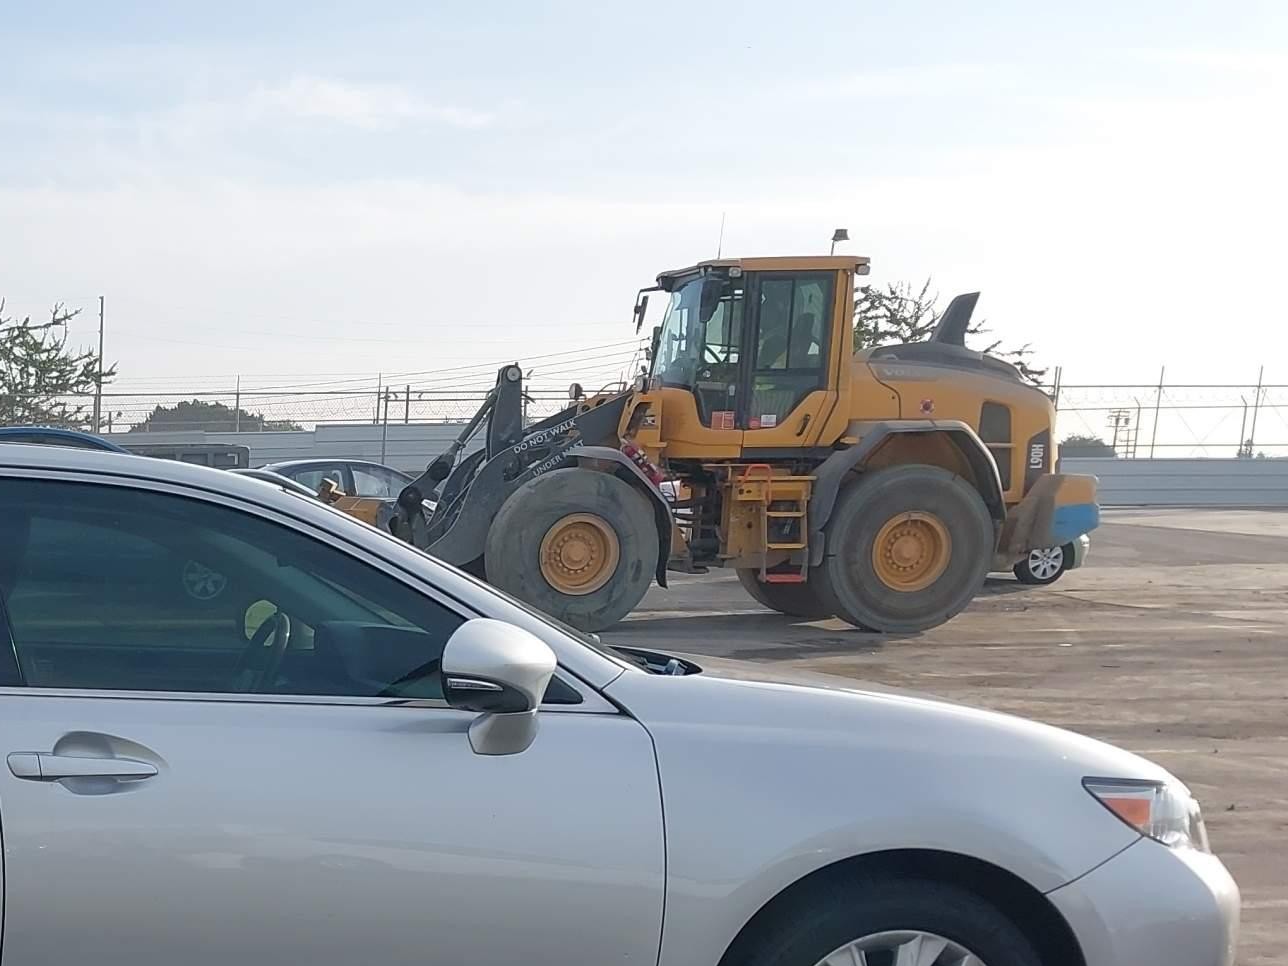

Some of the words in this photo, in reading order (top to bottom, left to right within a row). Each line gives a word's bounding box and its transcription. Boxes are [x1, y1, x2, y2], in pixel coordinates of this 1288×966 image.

[514, 443, 528, 454] DO
[530, 432, 548, 445] NOT
[550, 419, 577, 436] WALK
[533, 455, 562, 477] UNDER
[562, 439, 584, 458] MAST
[1030, 444, 1045, 469] L90H
